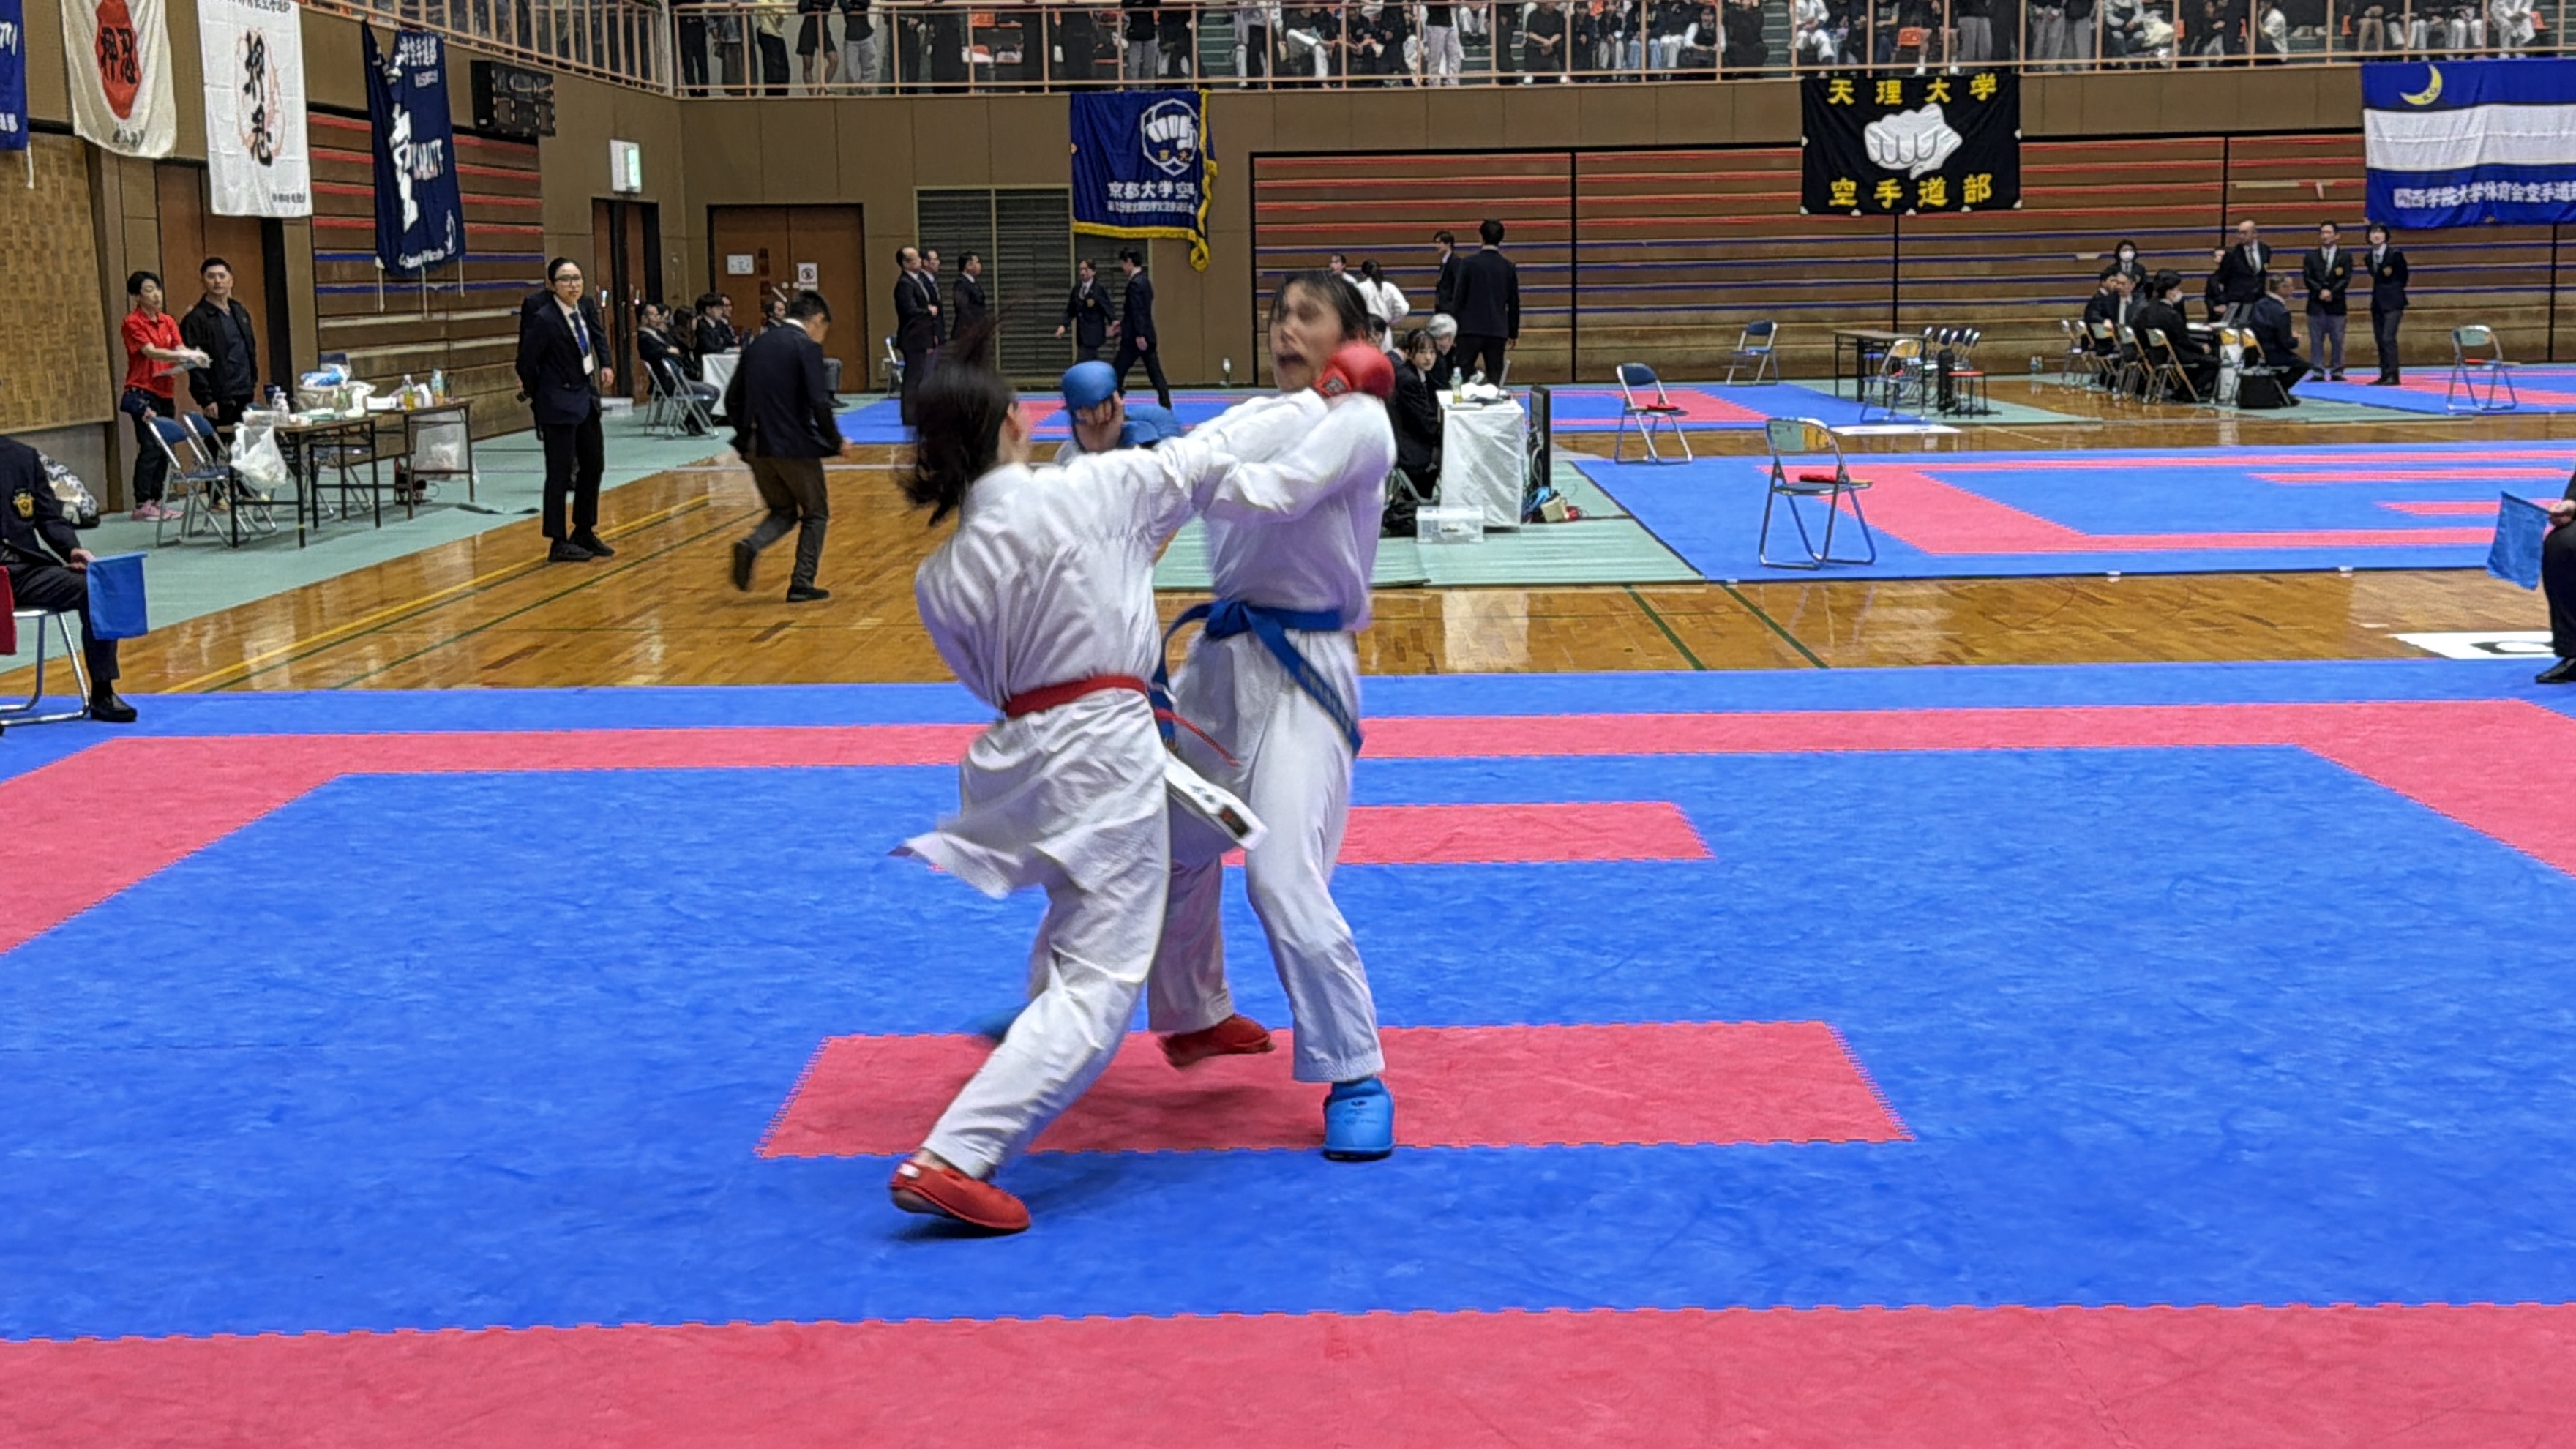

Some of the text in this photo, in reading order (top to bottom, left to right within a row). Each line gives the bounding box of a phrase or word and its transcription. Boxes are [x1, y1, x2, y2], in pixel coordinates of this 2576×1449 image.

[1828, 73, 1997, 105] 天理大学
[1829, 173, 1992, 209] 空手道部
